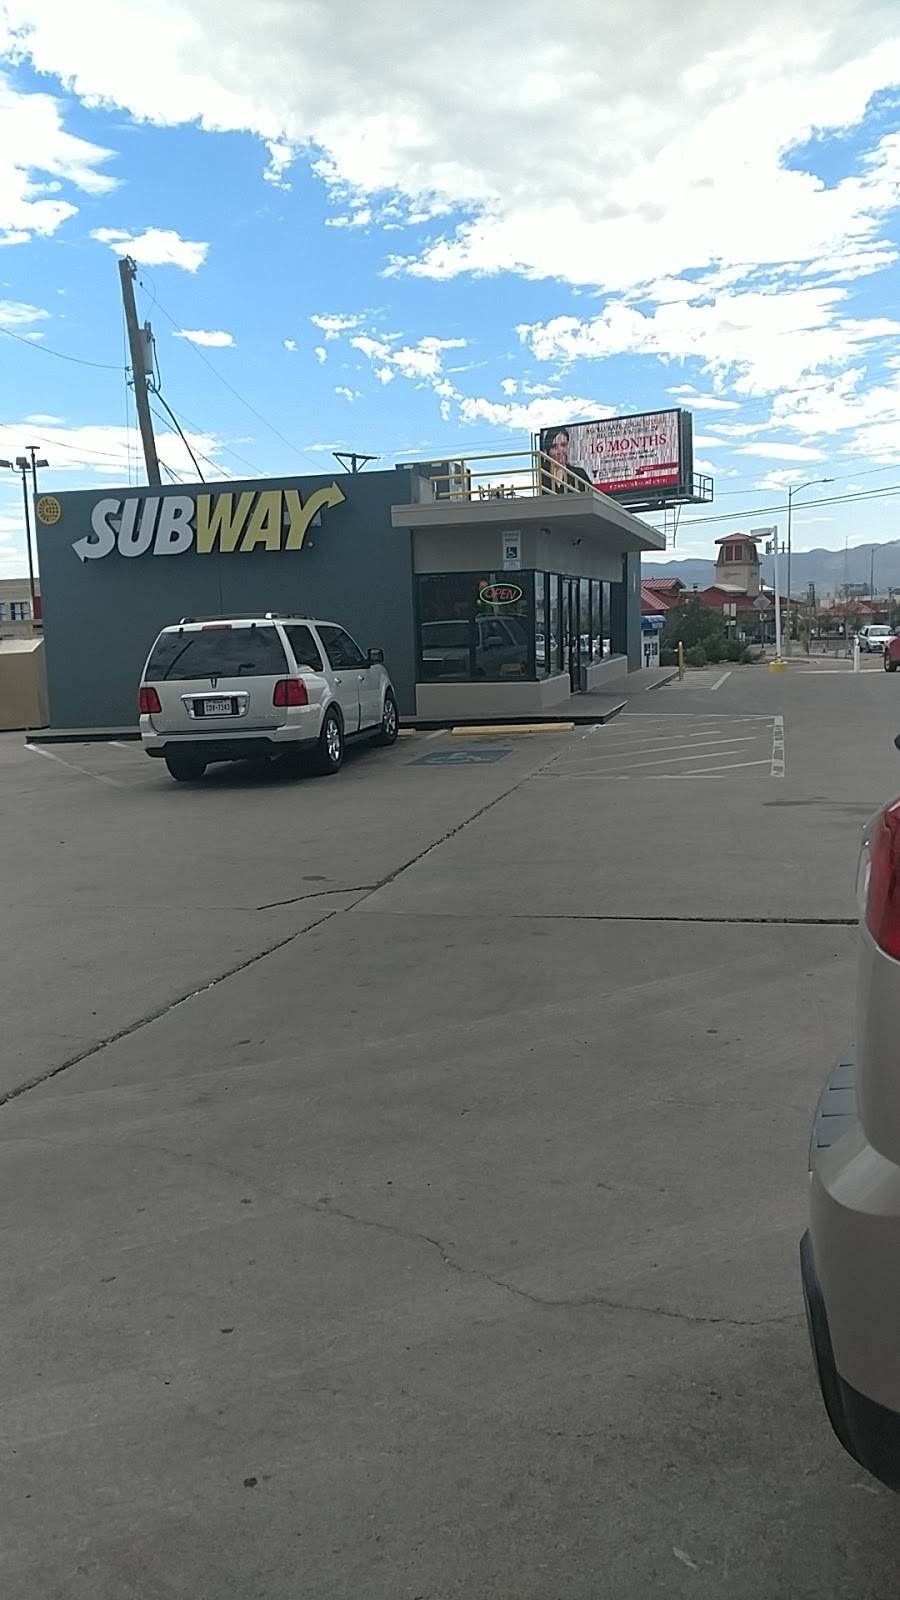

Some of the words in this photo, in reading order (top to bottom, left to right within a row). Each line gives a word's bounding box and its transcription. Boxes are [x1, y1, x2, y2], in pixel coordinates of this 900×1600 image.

[590, 442, 604, 455] 16
[607, 433, 667, 453] MONTHS
[72, 481, 346, 562] SUBWAY
[485, 588, 517, 600] OPEN
